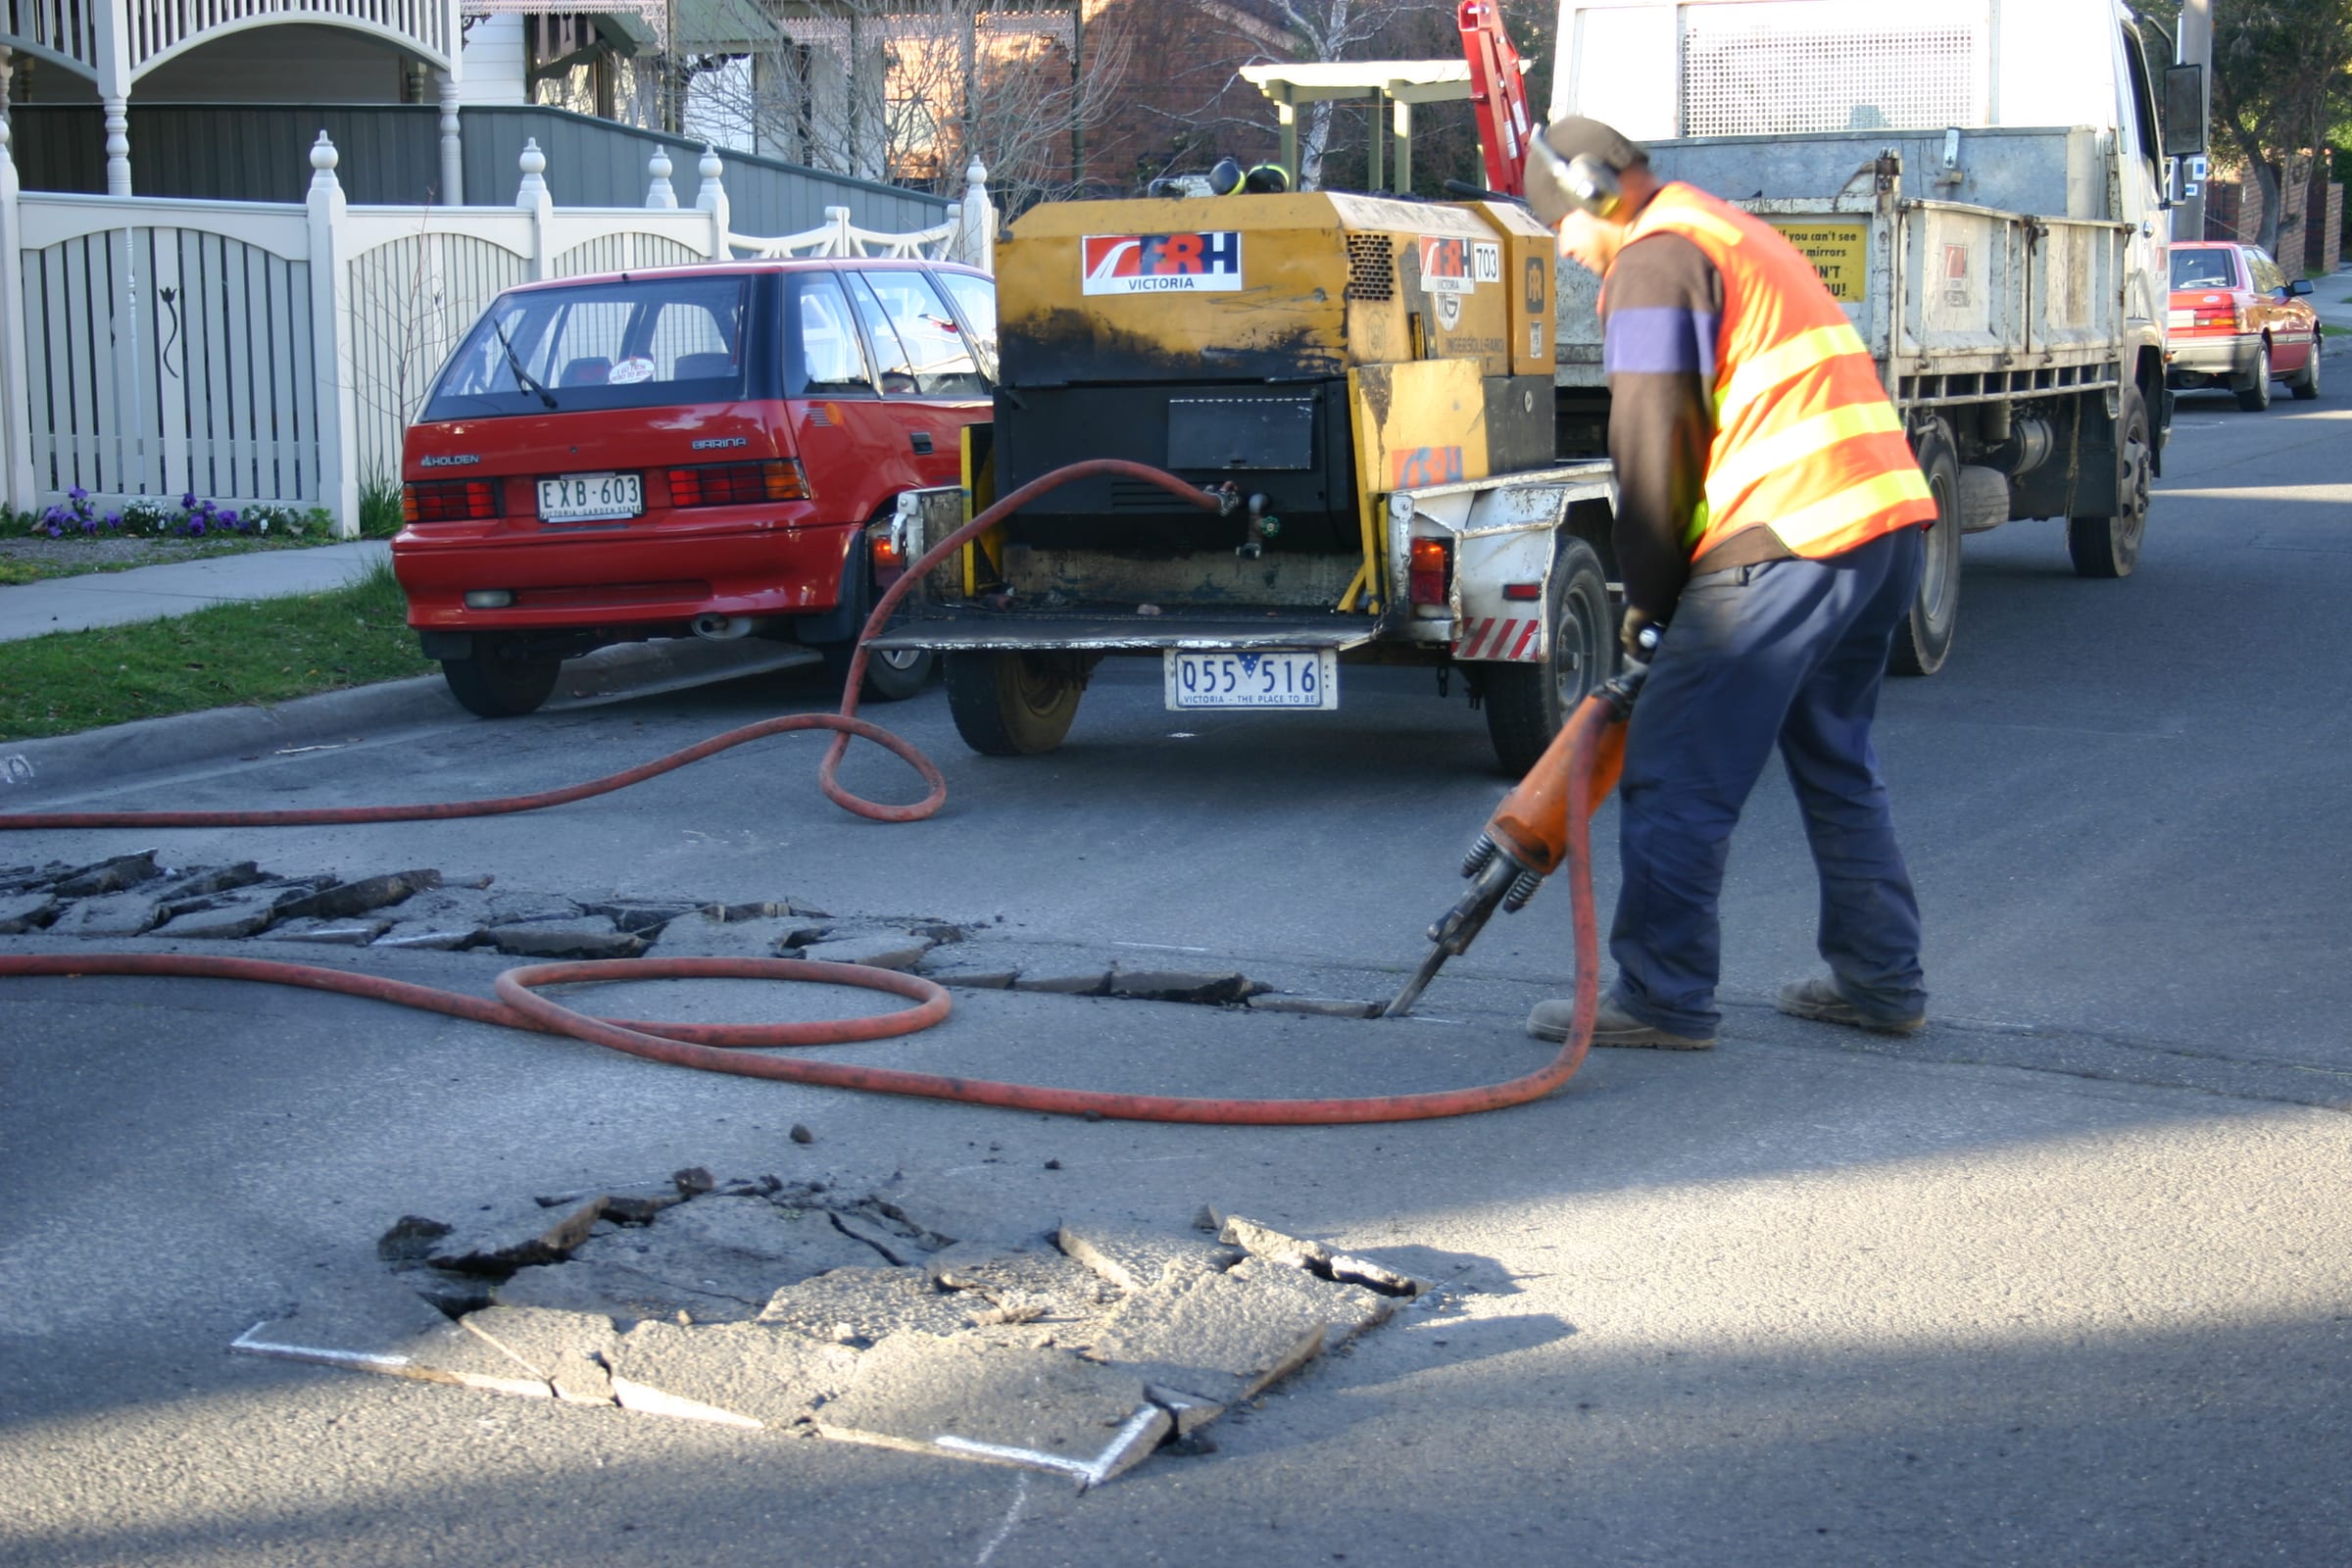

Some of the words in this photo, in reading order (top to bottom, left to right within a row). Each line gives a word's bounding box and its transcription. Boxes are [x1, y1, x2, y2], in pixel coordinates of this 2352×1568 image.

[1788, 233, 1808, 243] you
[1811, 230, 1836, 241] can't
[1838, 232, 1856, 241] see
[1806, 246, 1846, 257] mirrors
[1476, 248, 1497, 278] 703
[1128, 277, 1195, 290] VICTORIA
[692, 437, 747, 450] BARINA
[432, 455, 479, 466] HOLDEN
[584, 508, 614, 516] GARDEN
[618, 505, 641, 514] STATE
[1183, 660, 1236, 693] Q55
[1262, 660, 1316, 693] 516
[1184, 695, 1224, 704] VICTORIA
[1237, 695, 1253, 704] THE
[1258, 695, 1284, 704] PLACE
[1289, 695, 1300, 704] TO
[1304, 695, 1315, 704] BE
